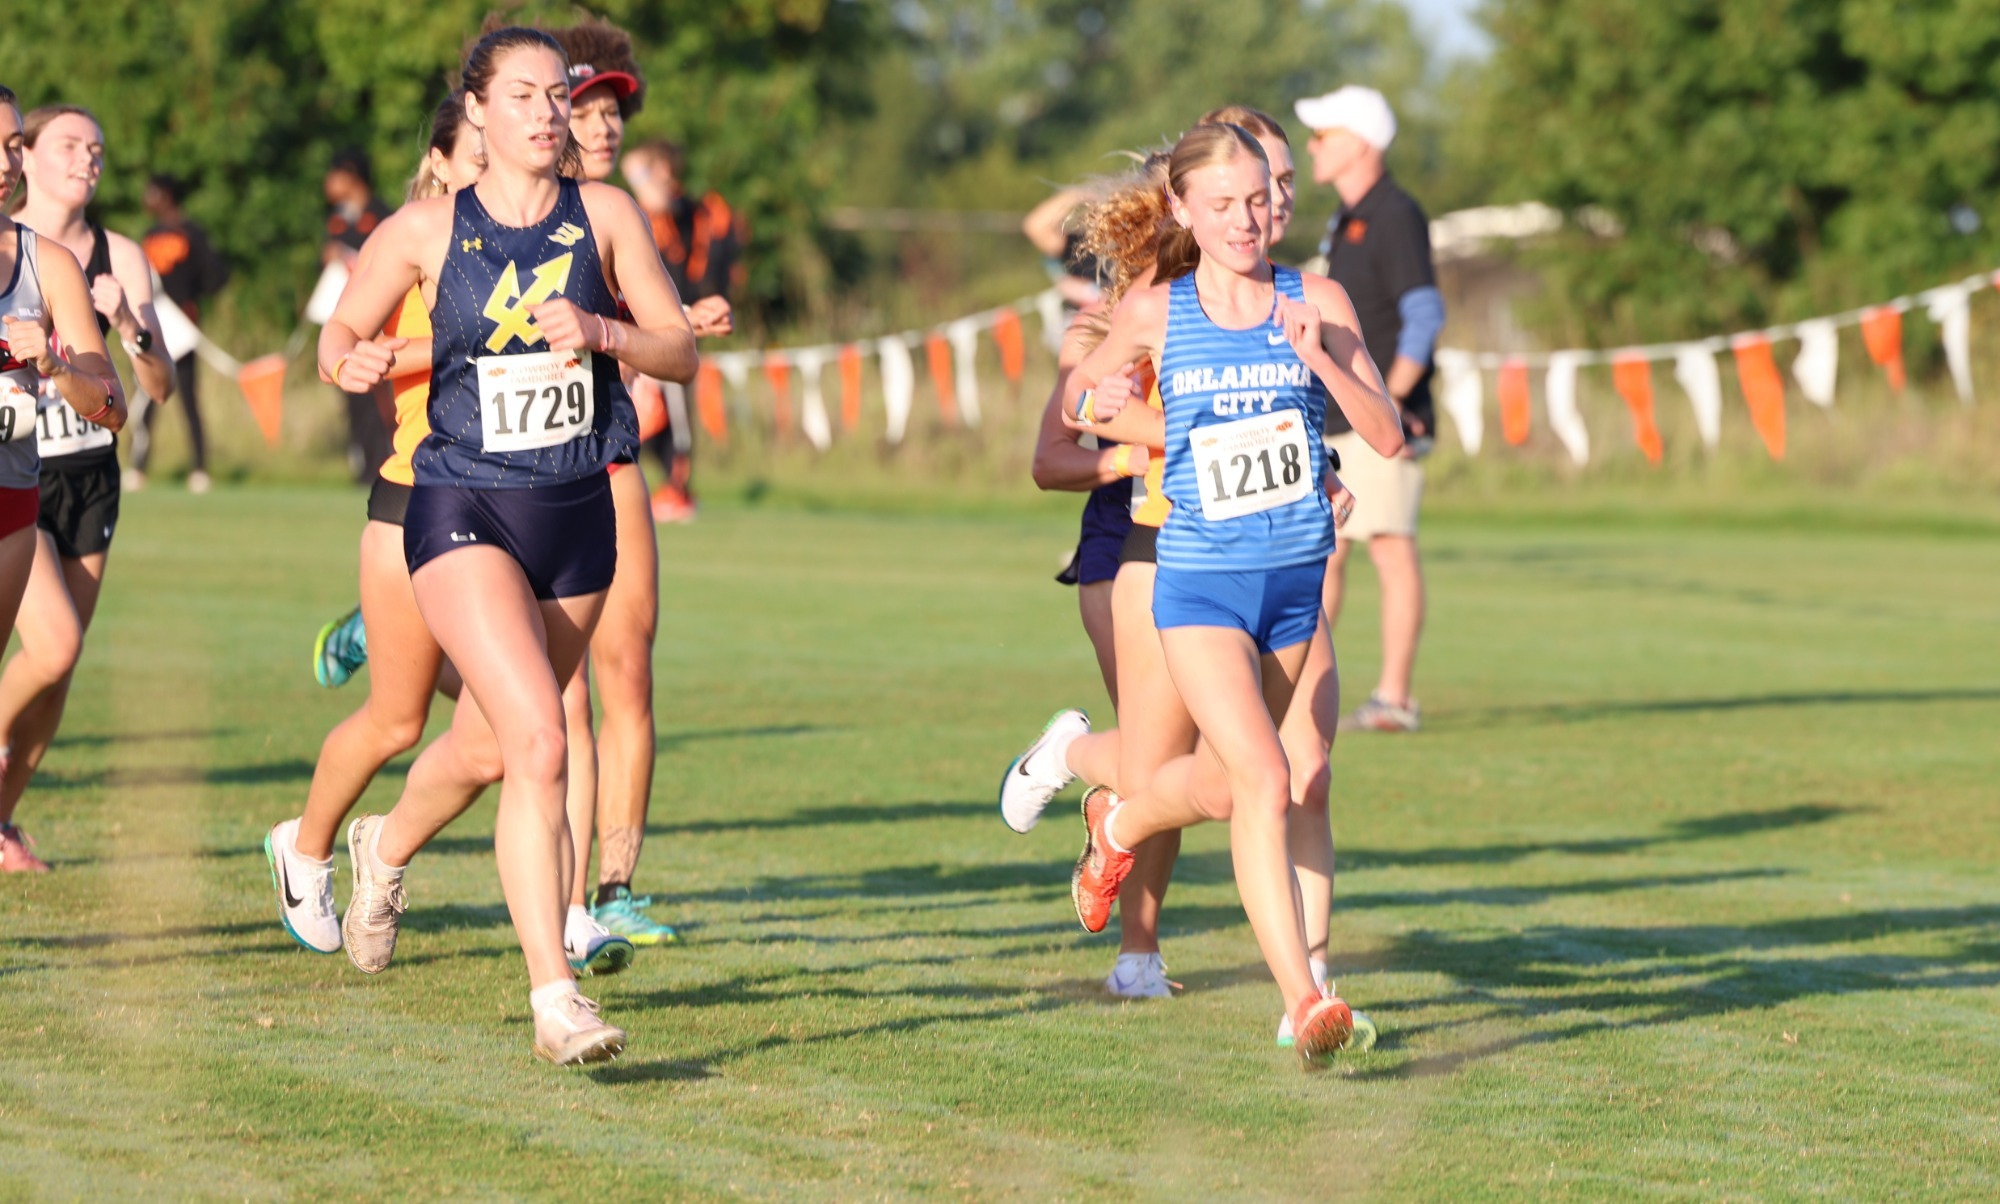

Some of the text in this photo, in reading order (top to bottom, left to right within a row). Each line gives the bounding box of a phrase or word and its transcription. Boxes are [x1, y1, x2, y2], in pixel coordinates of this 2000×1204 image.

[1172, 363, 1312, 397] OKLAHOMA
[491, 381, 586, 435] 1729
[1213, 389, 1278, 416] CITY
[1207, 443, 1301, 503] 1218
